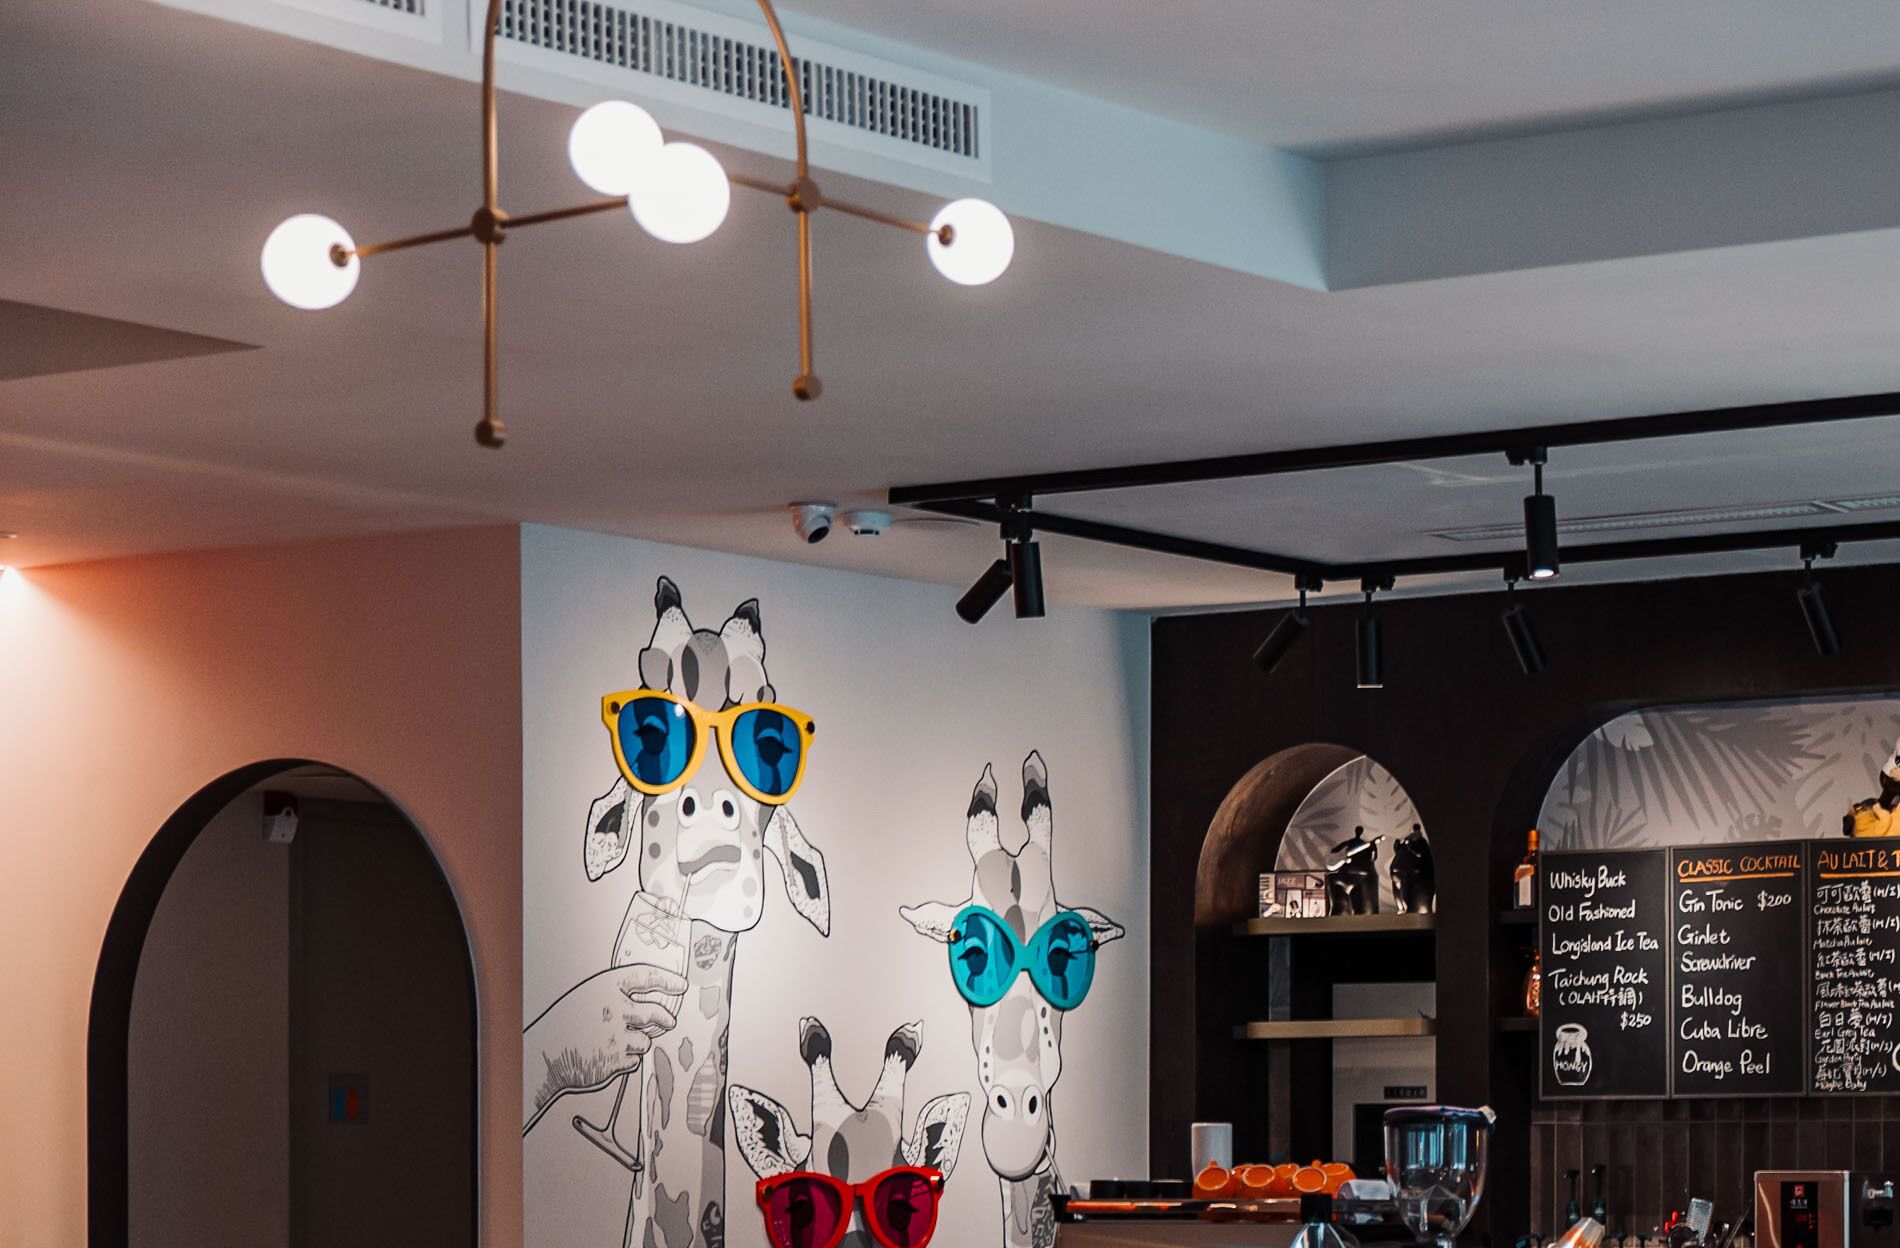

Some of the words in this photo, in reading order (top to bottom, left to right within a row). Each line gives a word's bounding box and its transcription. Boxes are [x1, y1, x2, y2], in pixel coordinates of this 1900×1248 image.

[1677, 859, 1733, 878] CLASSIC
[1740, 854, 1800, 873] COCKTAIL
[1817, 850, 1839, 870] AU
[1842, 848, 1875, 869] LAIT
[1877, 849, 1889, 870] &
[1550, 868, 1595, 898] Whisky
[1598, 864, 1626, 889] Buck
[1548, 904, 1573, 922] Old
[1579, 898, 1635, 921] Fashioned
[1679, 889, 1705, 913] Gin
[1705, 889, 1744, 912] Tonic
[1757, 890, 1792, 911] $200
[1552, 932, 1611, 960] Longisland
[1614, 929, 1635, 952] Ice
[1636, 931, 1659, 951] Tea
[1680, 951, 1756, 973] Screwdriver
[1548, 967, 1610, 994] Taichung
[1613, 964, 1649, 985] Rock
[1681, 984, 1742, 1016] Bulldog
[1620, 1011, 1651, 1030] $250
[1680, 1017, 1721, 1040] Cuba
[1727, 1018, 1768, 1040] Libre
[1814, 1027, 1834, 1039] Earl
[1837, 1028, 1857, 1040] Grey
[1860, 1025, 1876, 1038] Tea
[1682, 1050, 1733, 1080] Orange
[1740, 1048, 1771, 1075] Peel
